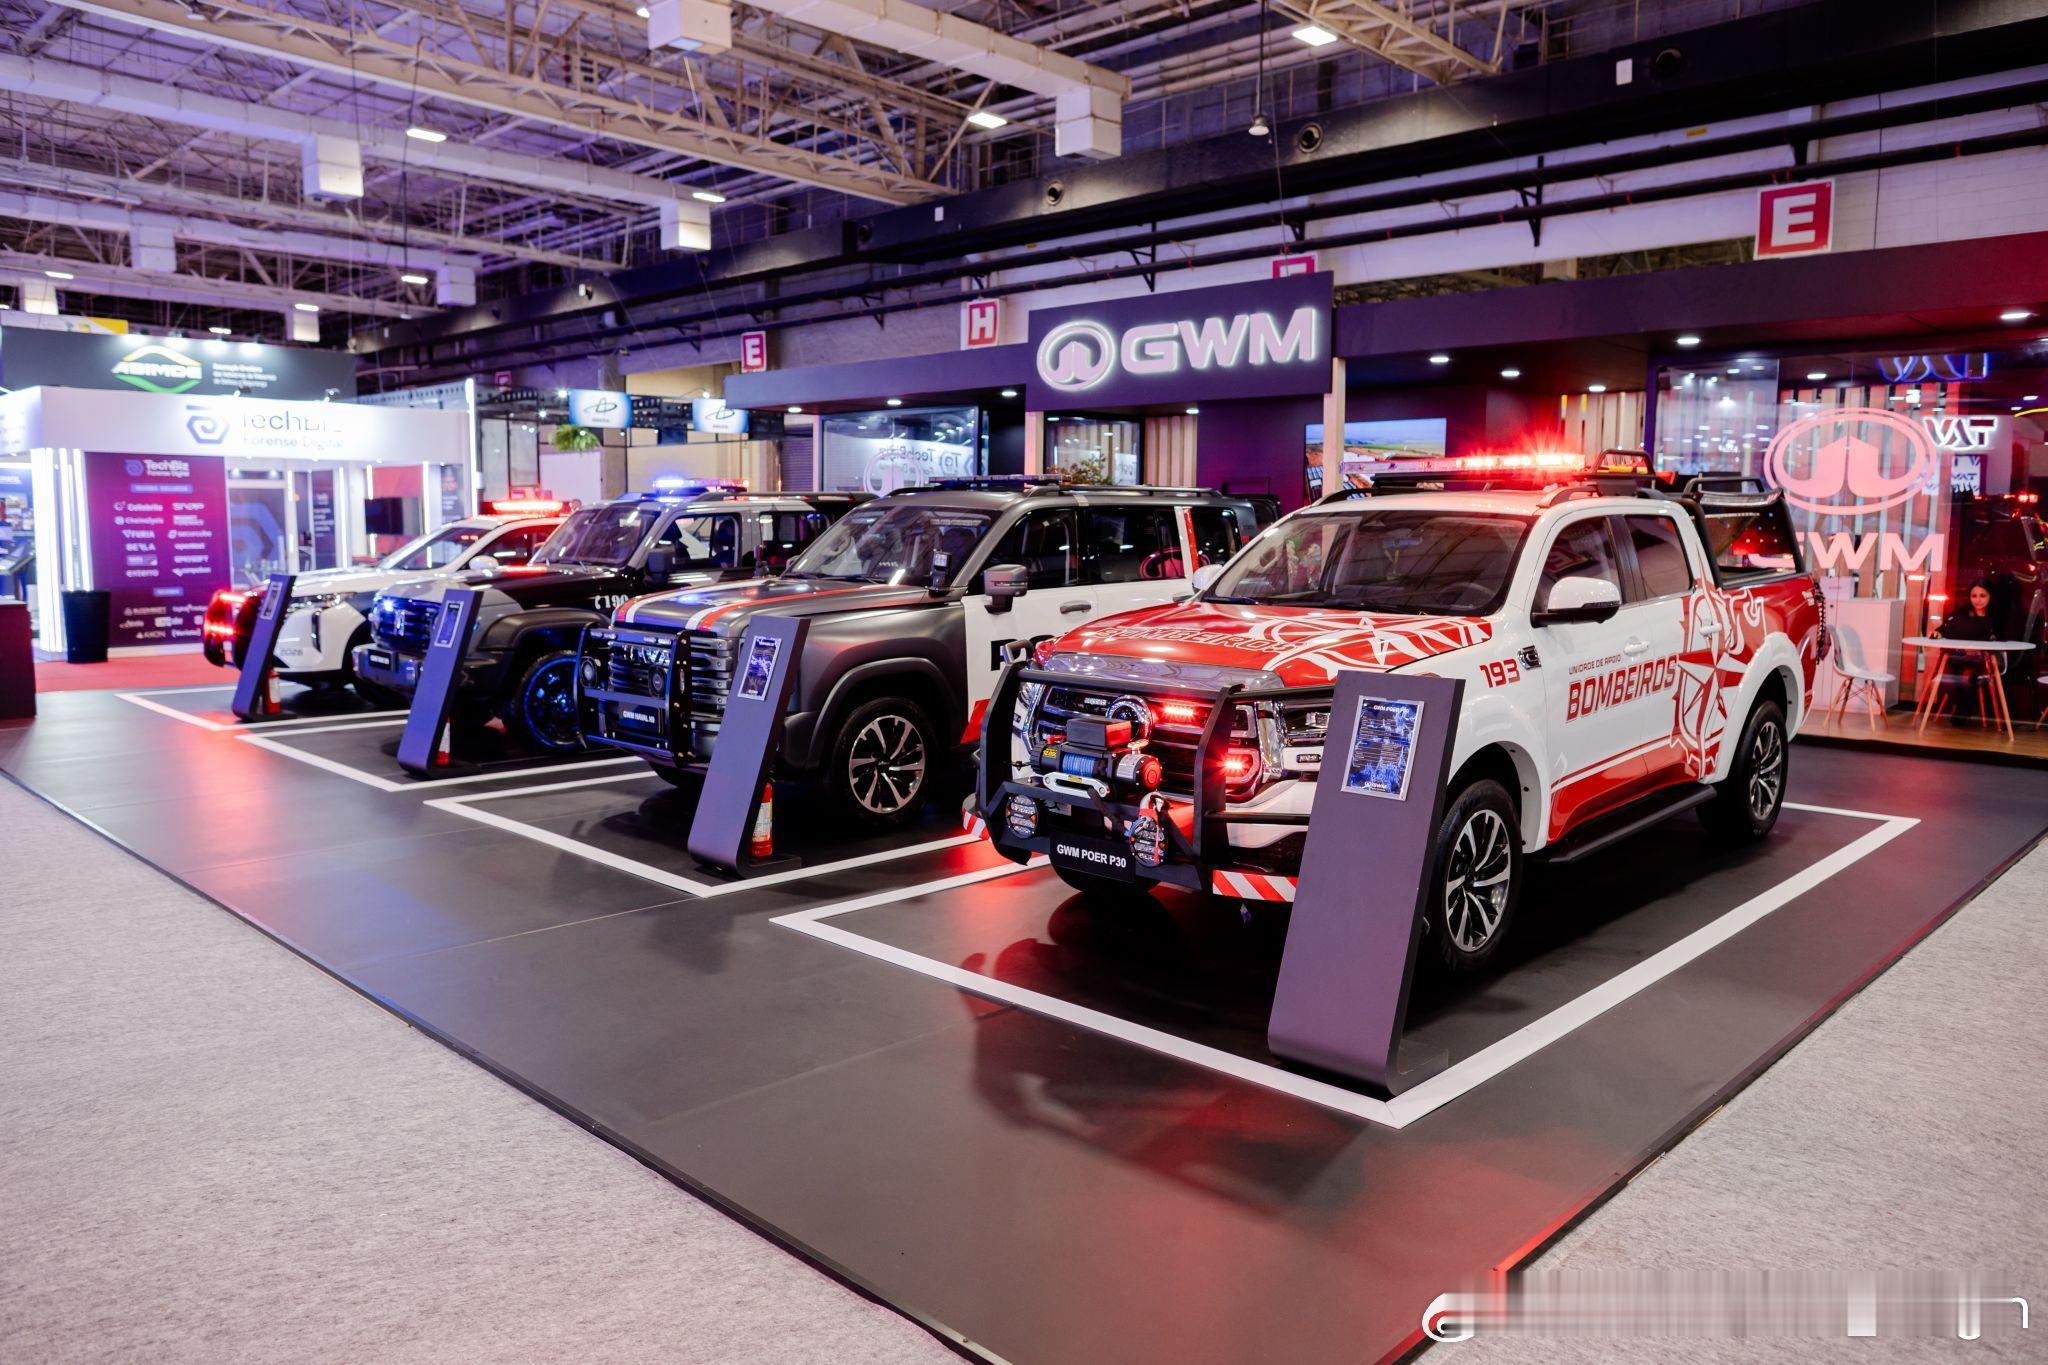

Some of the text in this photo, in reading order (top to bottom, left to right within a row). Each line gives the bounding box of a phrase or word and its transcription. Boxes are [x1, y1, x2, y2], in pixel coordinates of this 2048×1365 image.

[1770, 191, 1817, 248] E
[971, 305, 995, 340] H
[744, 337, 762, 366] E
[1120, 306, 1318, 375] GWM
[1796, 531, 1945, 572] WM
[603, 594, 629, 610] 190
[1479, 658, 1521, 689] 193
[1568, 653, 1622, 675] UNIDADE DE APOIO
[1566, 654, 1678, 723] BOMBEIROS
[1056, 844, 1127, 868] GWM POER P30
